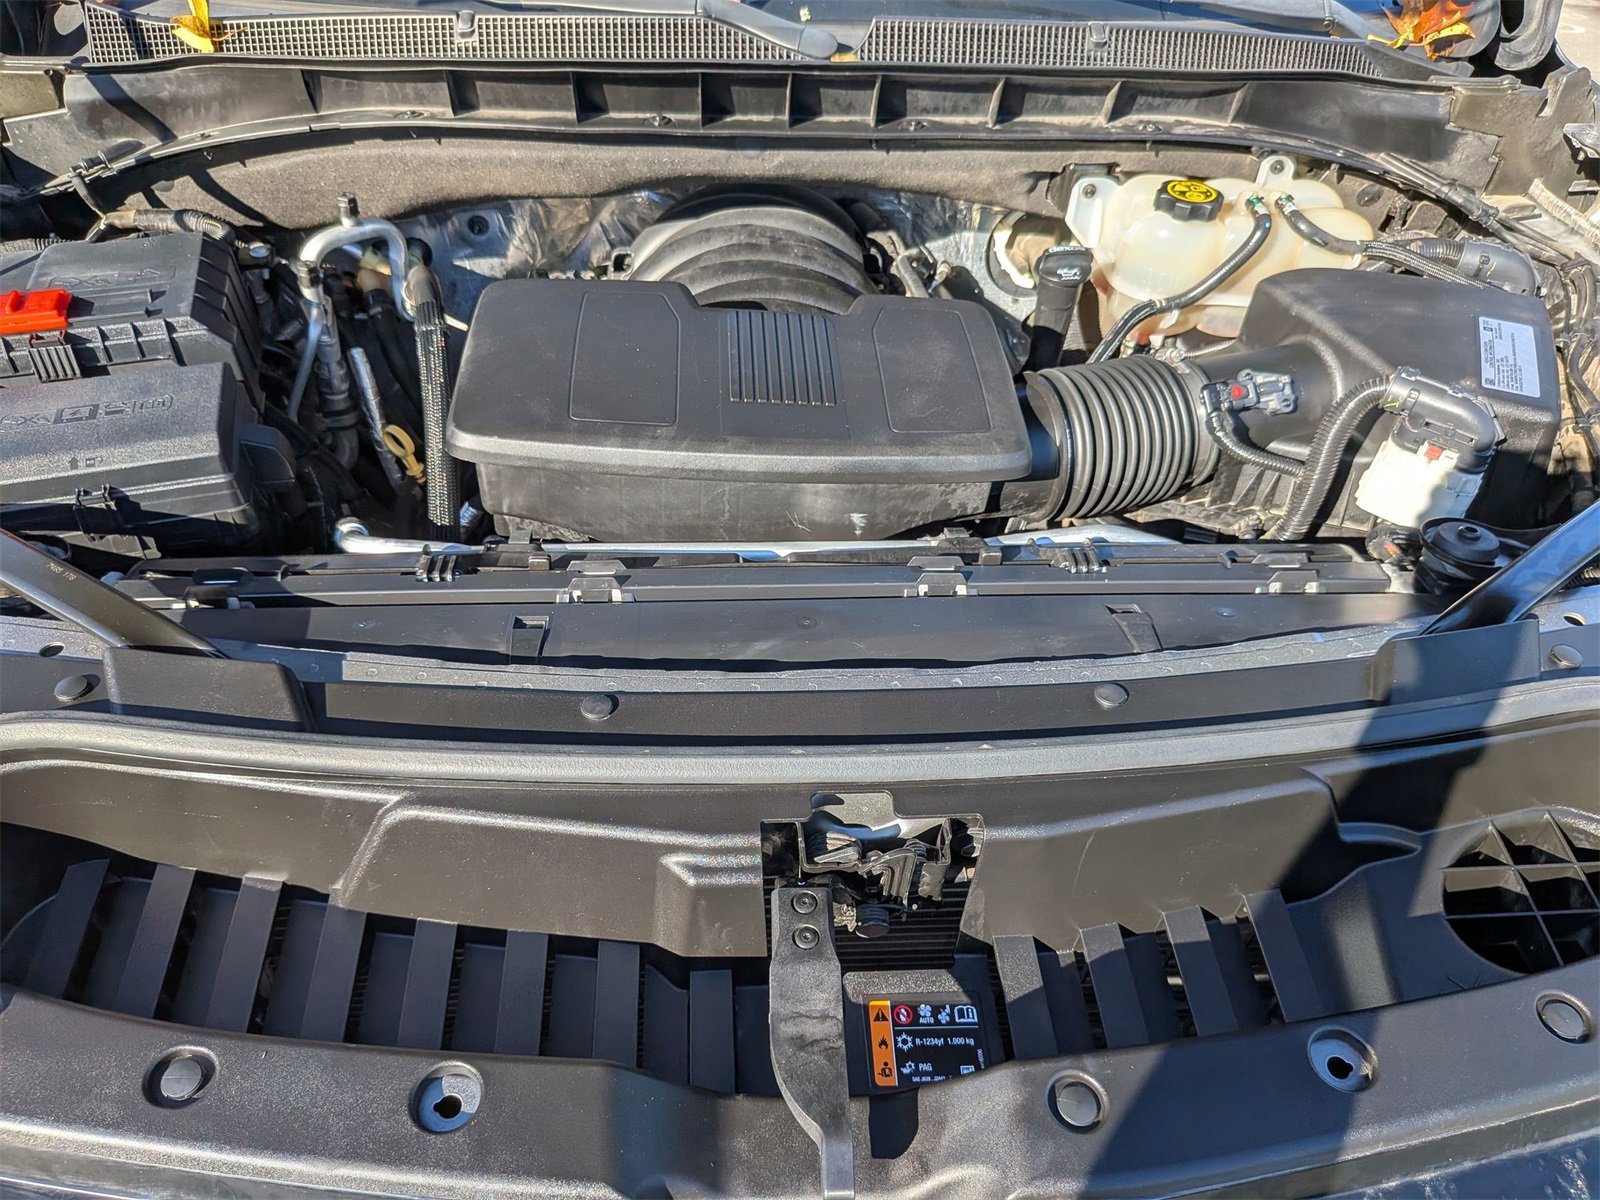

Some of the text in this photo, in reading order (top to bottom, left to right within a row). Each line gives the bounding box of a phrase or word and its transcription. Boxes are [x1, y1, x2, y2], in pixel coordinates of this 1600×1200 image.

[915, 1037, 975, 1047] R-1234yf 1.000 kg
[918, 1063, 932, 1072] PAG
